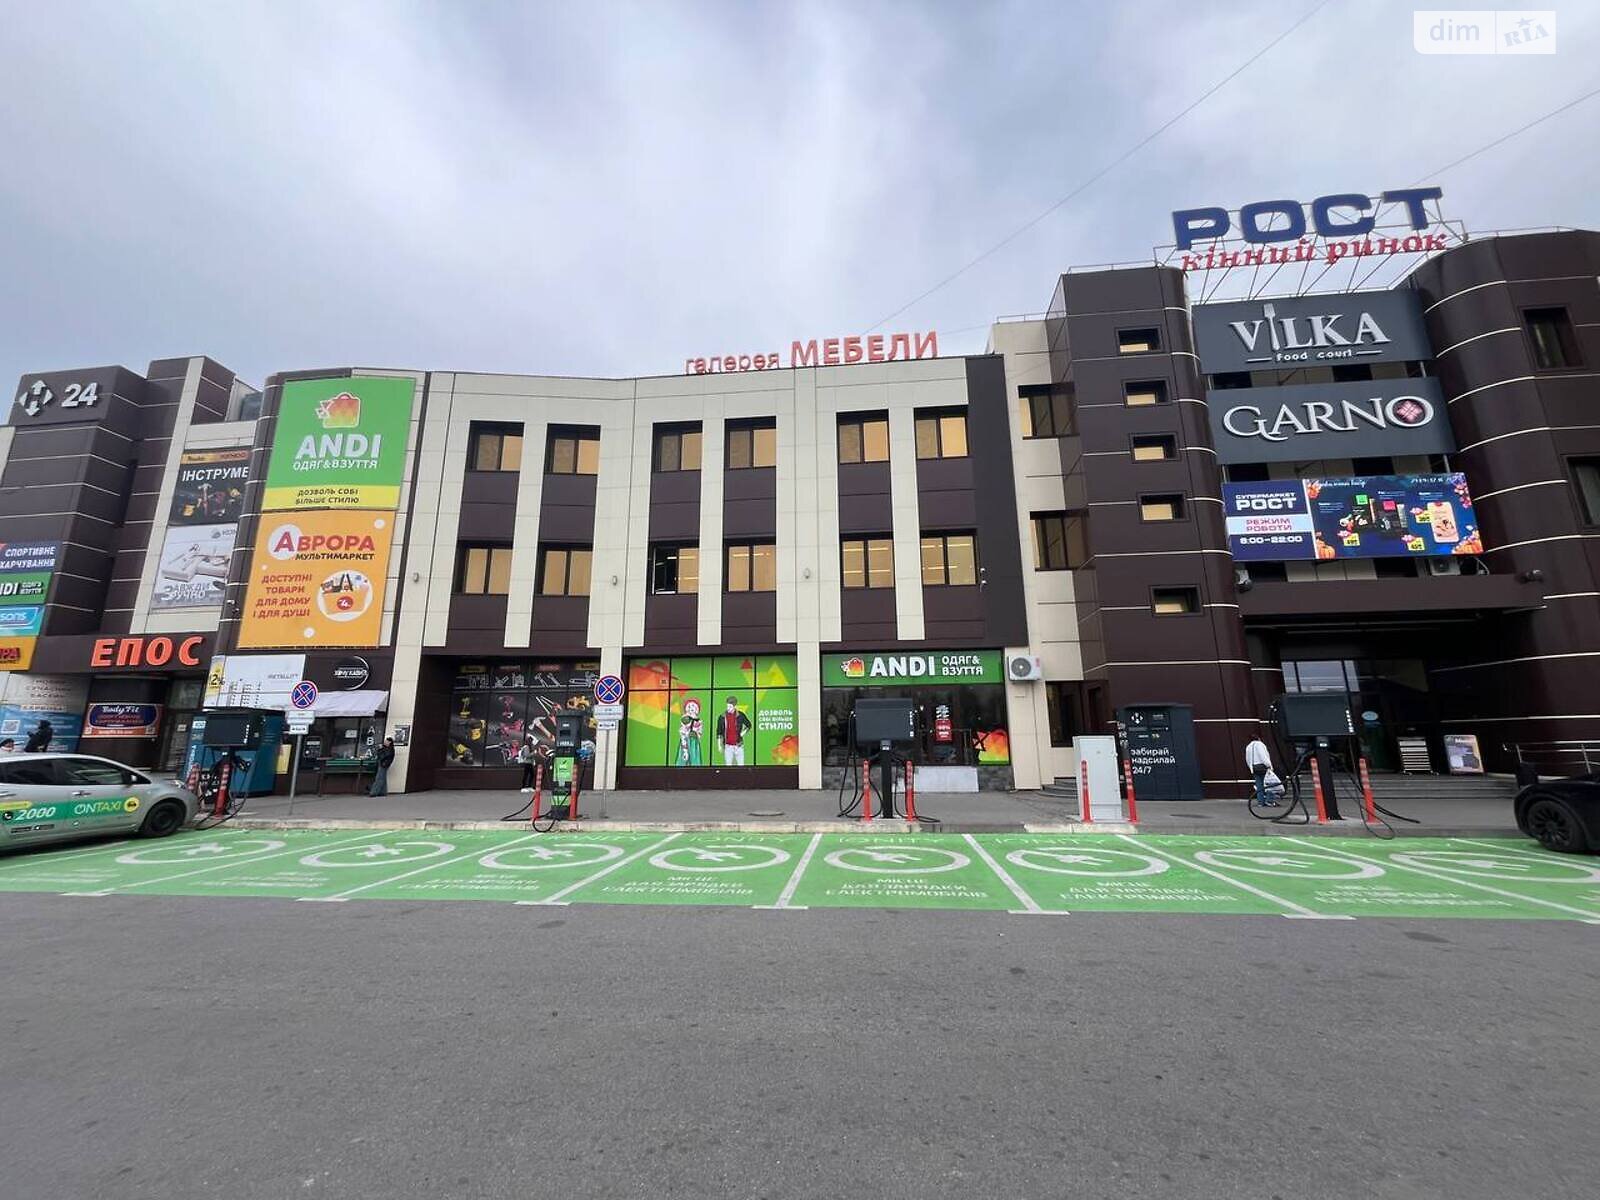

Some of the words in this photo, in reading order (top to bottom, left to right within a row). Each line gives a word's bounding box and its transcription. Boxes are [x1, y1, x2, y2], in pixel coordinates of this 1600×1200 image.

[1172, 187, 1443, 251] РОСТ
[1182, 239, 1315, 272] кінний
[1326, 234, 1447, 266] ринок
[1229, 303, 1391, 352] VILKA
[685, 353, 779, 376] галерея
[791, 331, 938, 368] МЕБЕЛИ
[1277, 351, 1308, 362] food
[1317, 349, 1352, 359] court
[61, 382, 98, 408] 24
[1223, 395, 1435, 442] GARNO
[295, 432, 381, 459] ANDI
[293, 459, 378, 472] ОДЯГ&ВЗУТТЯ
[298, 488, 335, 497] ДОЗВОЛЬ
[1235, 492, 1296, 500] СУПЕРМАРКЕТ
[295, 497, 325, 505] БІЛЬШЕ
[328, 496, 359, 505] СТИЛЮ
[1235, 498, 1297, 511] РОСТ
[274, 530, 376, 553] АВРОРА
[5, 546, 57, 558] СПОРТИВНЕ
[295, 552, 375, 561] МУЛЬТИМАРКЕТ
[261, 573, 312, 584] ДОСТУПНІ
[265, 586, 305, 596] ТОВАРИ
[256, 598, 280, 607] ДЛЯ
[281, 597, 310, 606] ДОМУ
[260, 610, 282, 619] ДЛЯ
[283, 609, 310, 618] ДУШІ
[90, 637, 205, 668] ЕПОС
[869, 656, 936, 678] ANDI
[941, 655, 979, 667] ОДЯГ&
[941, 665, 984, 676] ВЗУТТЯ
[759, 722, 794, 731] СТИЛЮ
[1130, 746, 1169, 757] забирай
[1131, 755, 1176, 765] надсилай
[1131, 765, 1152, 775] 24/7
[16, 806, 56, 821] 2000
[74, 800, 121, 816] ONTAXI
